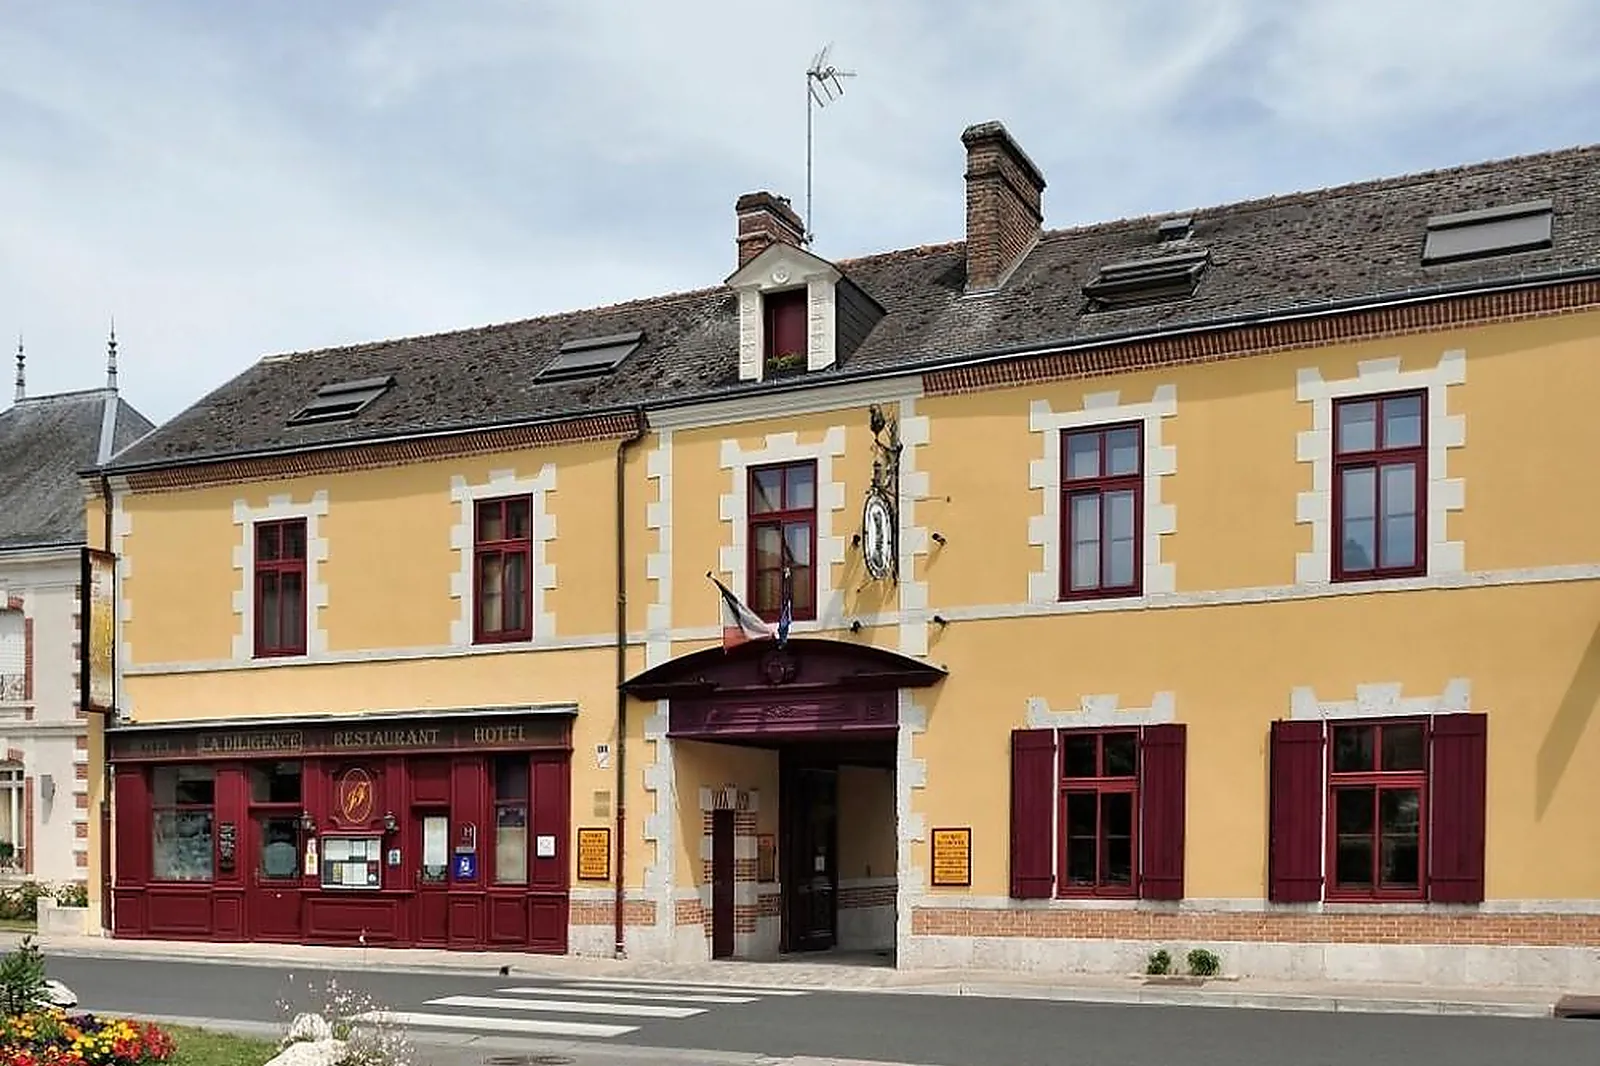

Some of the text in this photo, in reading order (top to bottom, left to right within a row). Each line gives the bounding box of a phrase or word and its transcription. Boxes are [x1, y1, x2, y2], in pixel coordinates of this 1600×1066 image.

[201, 732, 302, 752] LA DILIGENCE
[333, 728, 440, 748] RESTAURANT
[473, 724, 526, 744] HOTEL
